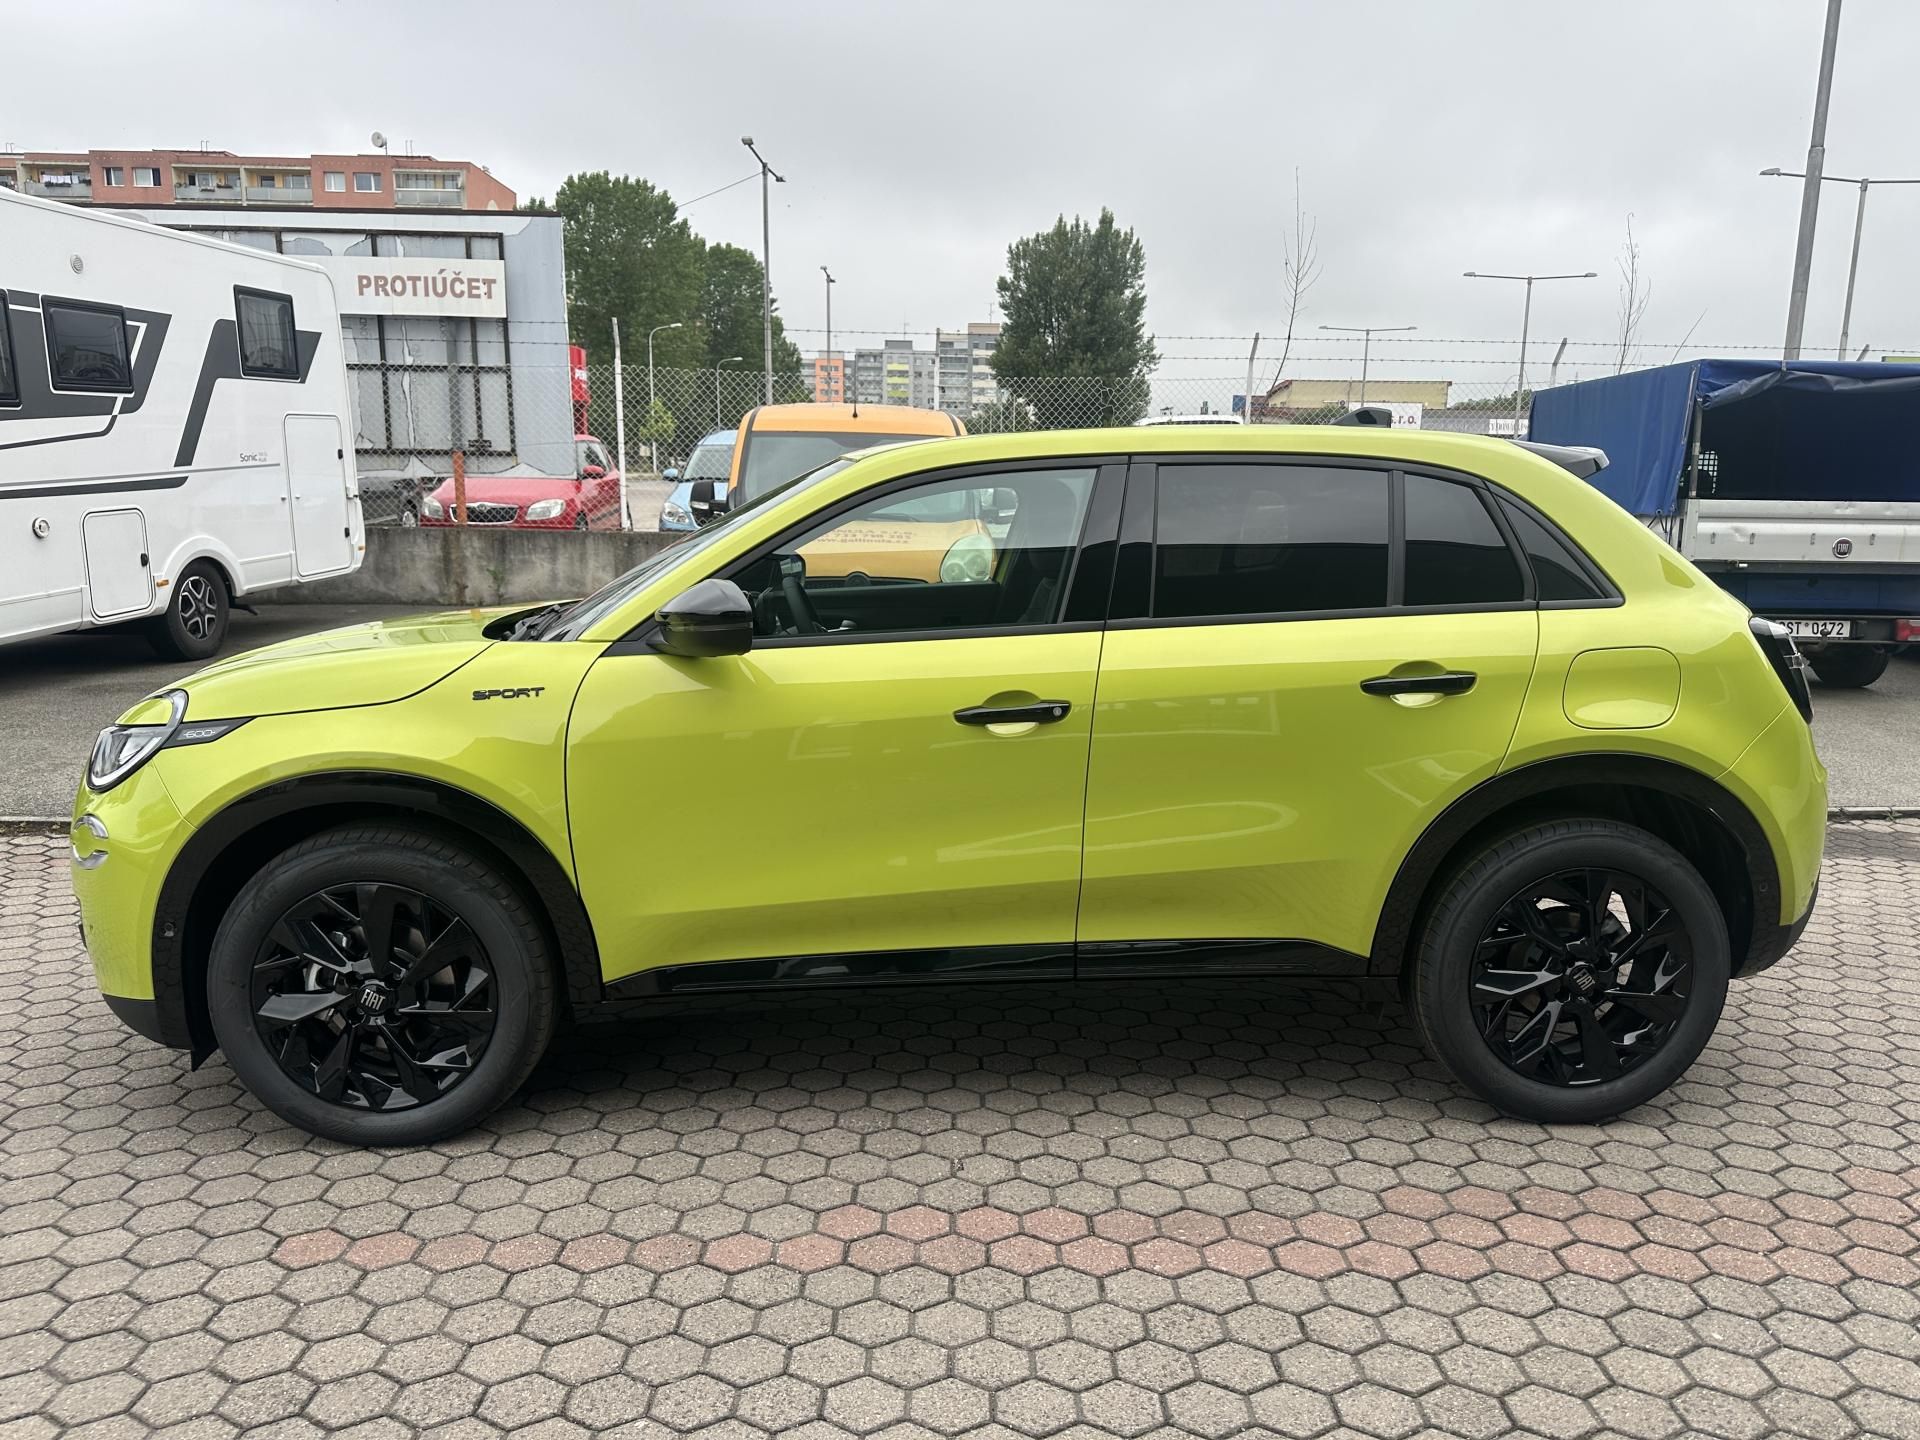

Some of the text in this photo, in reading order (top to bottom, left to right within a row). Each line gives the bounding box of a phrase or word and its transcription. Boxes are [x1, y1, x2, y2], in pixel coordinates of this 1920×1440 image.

[357, 269, 497, 299] PROTIÚČET
[239, 452, 258, 462] Sonic
[472, 686, 545, 701] SPORT
[184, 729, 215, 738] 600
[1573, 968, 1595, 990] FIAT
[361, 988, 386, 1010] FIAT
